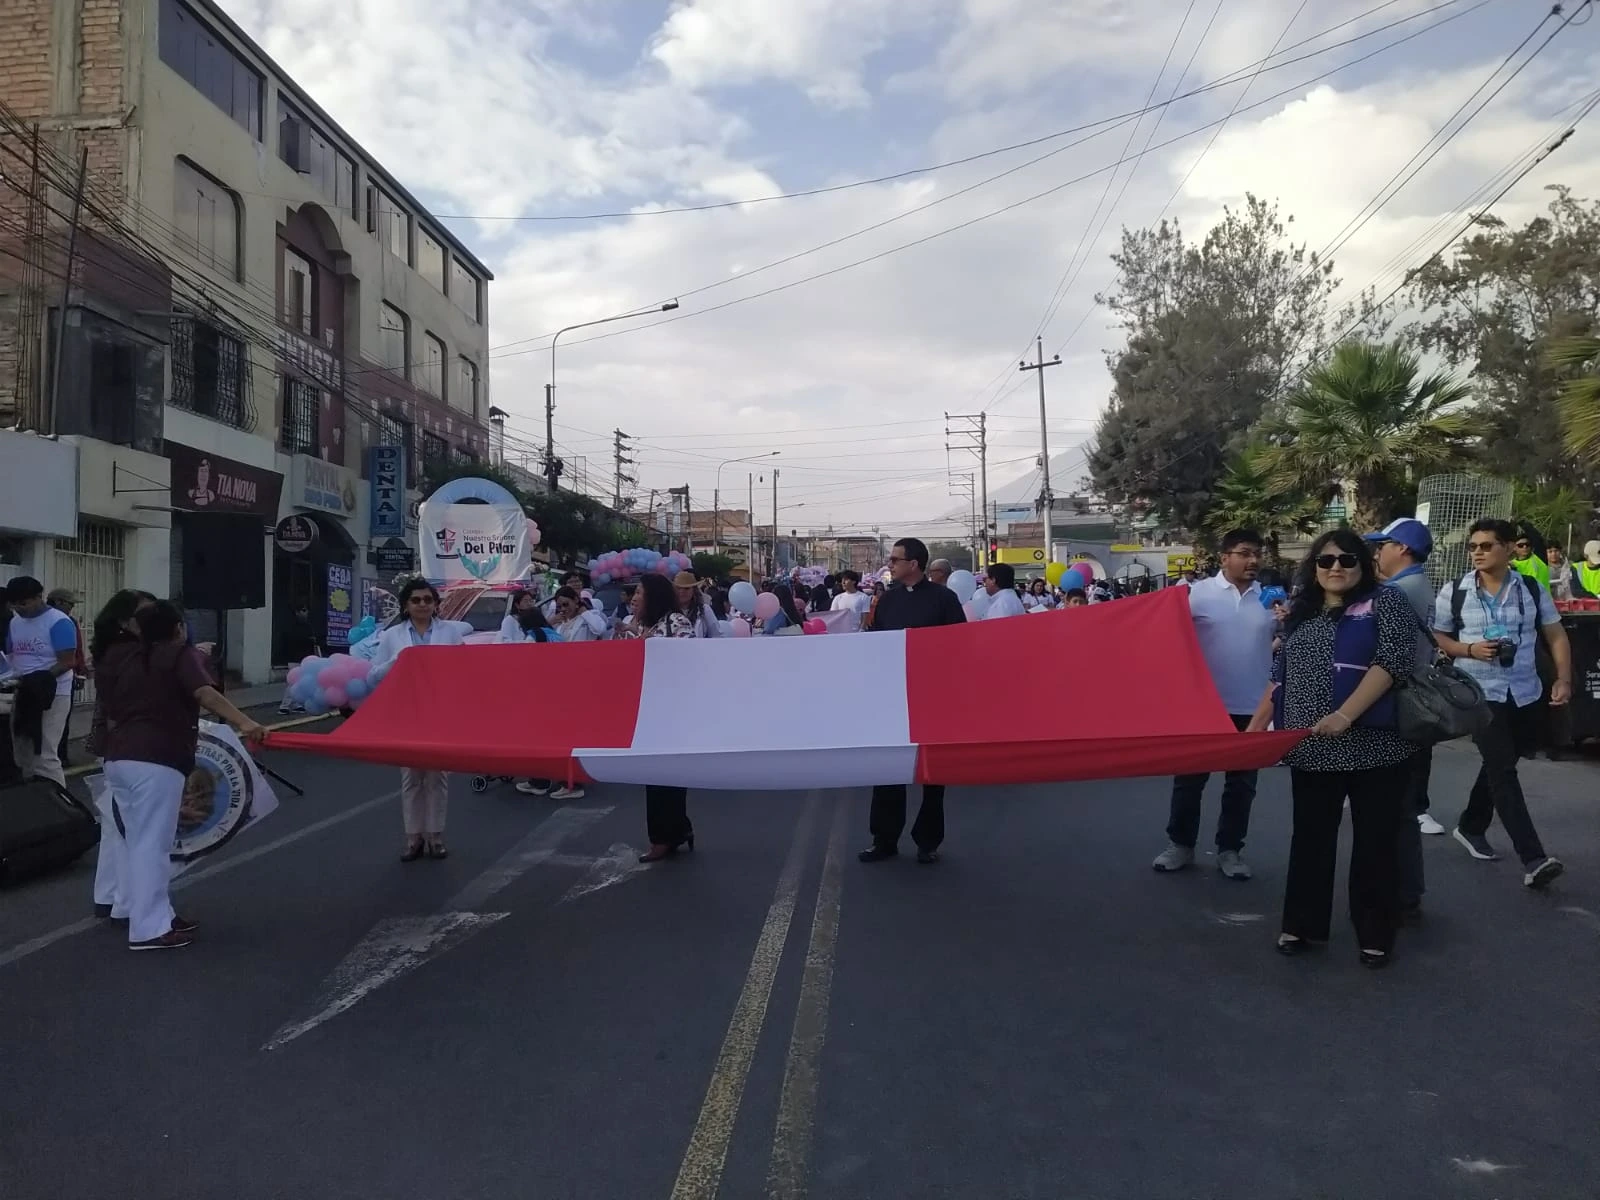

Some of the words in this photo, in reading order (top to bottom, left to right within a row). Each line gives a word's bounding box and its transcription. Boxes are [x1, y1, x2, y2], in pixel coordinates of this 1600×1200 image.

[232, 478, 257, 503] NOVA
[376, 448, 397, 525] DENTAL
[464, 541, 484, 554] Del
[489, 541, 516, 554] Pilar
[329, 566, 351, 584] CEBA
[195, 744, 223, 762] ETRAS
[222, 759, 235, 776] POR
[230, 774, 239, 787] LA
[230, 789, 240, 809] VIDA
